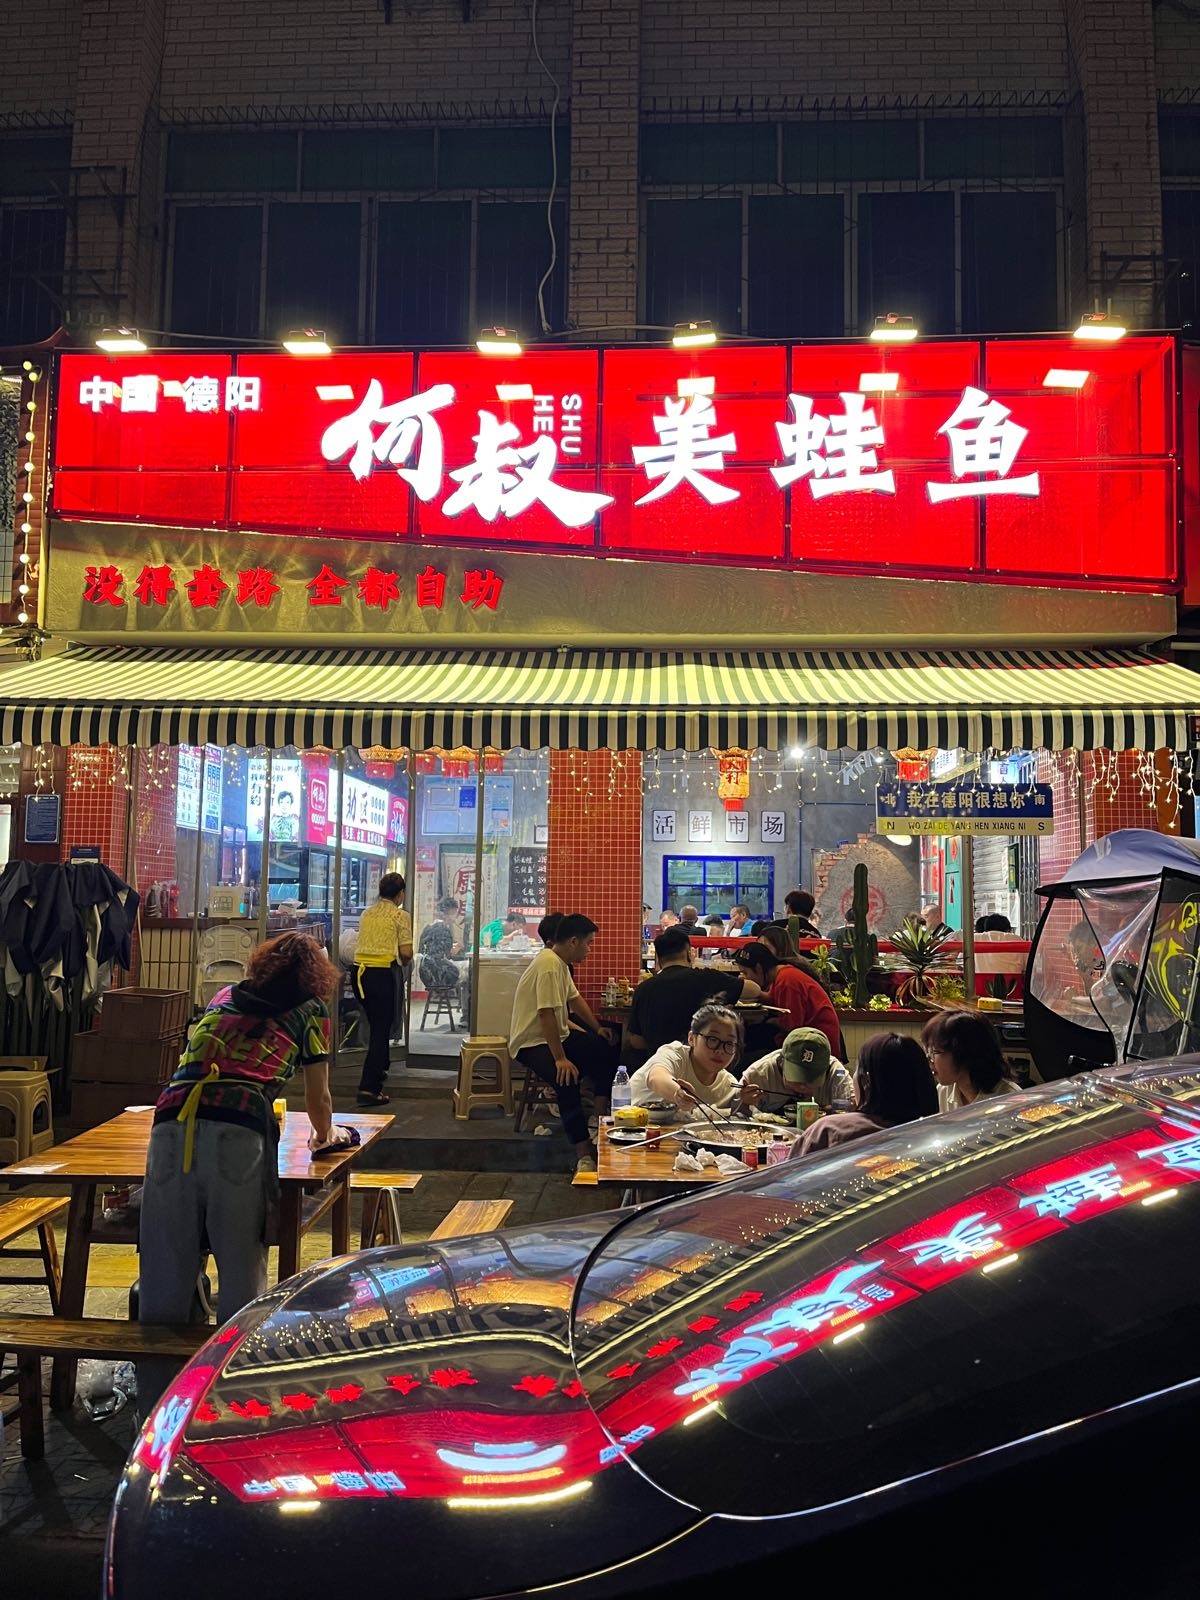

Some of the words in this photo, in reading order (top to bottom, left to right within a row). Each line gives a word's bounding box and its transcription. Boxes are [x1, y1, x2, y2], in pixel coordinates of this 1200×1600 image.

[533, 394, 554, 432] HE
[560, 393, 582, 456] SHU
[304, 563, 505, 611] 全都自助
[906, 789, 1026, 809] 我在德阳很想你
[1034, 793, 1046, 806] 南
[654, 814, 784, 836] 活鲜市场
[886, 821, 895, 831] N
[907, 821, 921, 831] WO
[923, 821, 936, 830] ZAI
[938, 821, 949, 830] DE
[974, 822, 989, 831] HEN
[992, 822, 1015, 831] XIANG
[1018, 822, 1026, 831] NI
[1037, 821, 1046, 831] S
